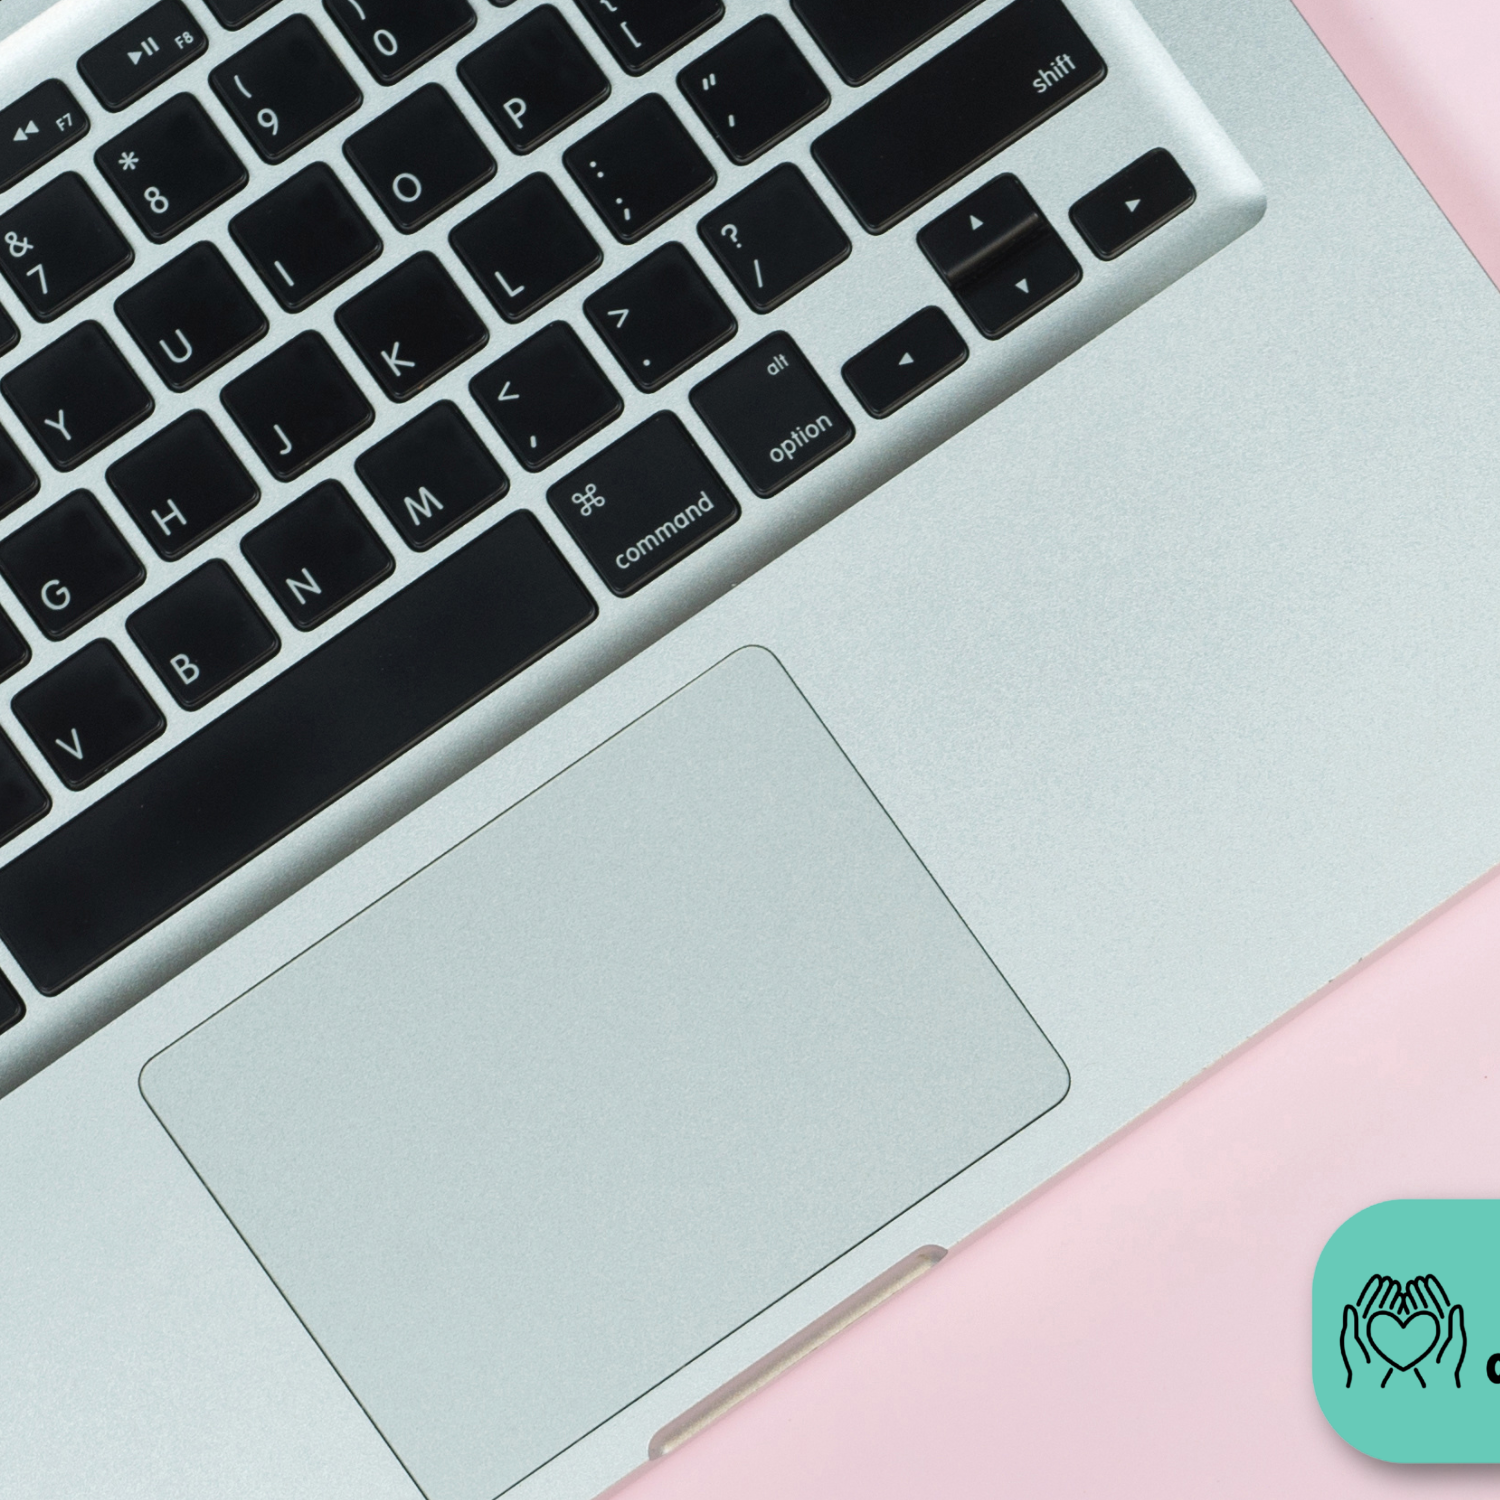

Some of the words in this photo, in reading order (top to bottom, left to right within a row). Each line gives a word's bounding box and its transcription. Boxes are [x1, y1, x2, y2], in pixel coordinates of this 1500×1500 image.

[173, 30, 195, 51] F8
[373, 29, 398, 56] 0
[233, 74, 252, 99] (
[1031, 52, 1077, 94] shift
[54, 111, 74, 133] F7
[257, 108, 279, 136] 9
[503, 97, 527, 129] P
[143, 186, 169, 214] 8
[392, 172, 422, 203] O
[4, 231, 34, 258] &
[720, 222, 743, 249] ?
[26, 263, 48, 295] 7
[274, 260, 295, 287] I
[494, 271, 525, 297] L
[159, 329, 193, 363] U
[380, 341, 416, 377] K
[766, 352, 790, 377] alt
[44, 409, 72, 441] Y
[273, 424, 293, 456] J
[768, 412, 834, 464] option
[151, 498, 187, 536] H
[403, 486, 444, 526] M
[614, 489, 716, 570] command
[41, 579, 71, 610] G
[285, 567, 322, 605] N
[169, 653, 200, 685] B
[55, 728, 83, 760] V
